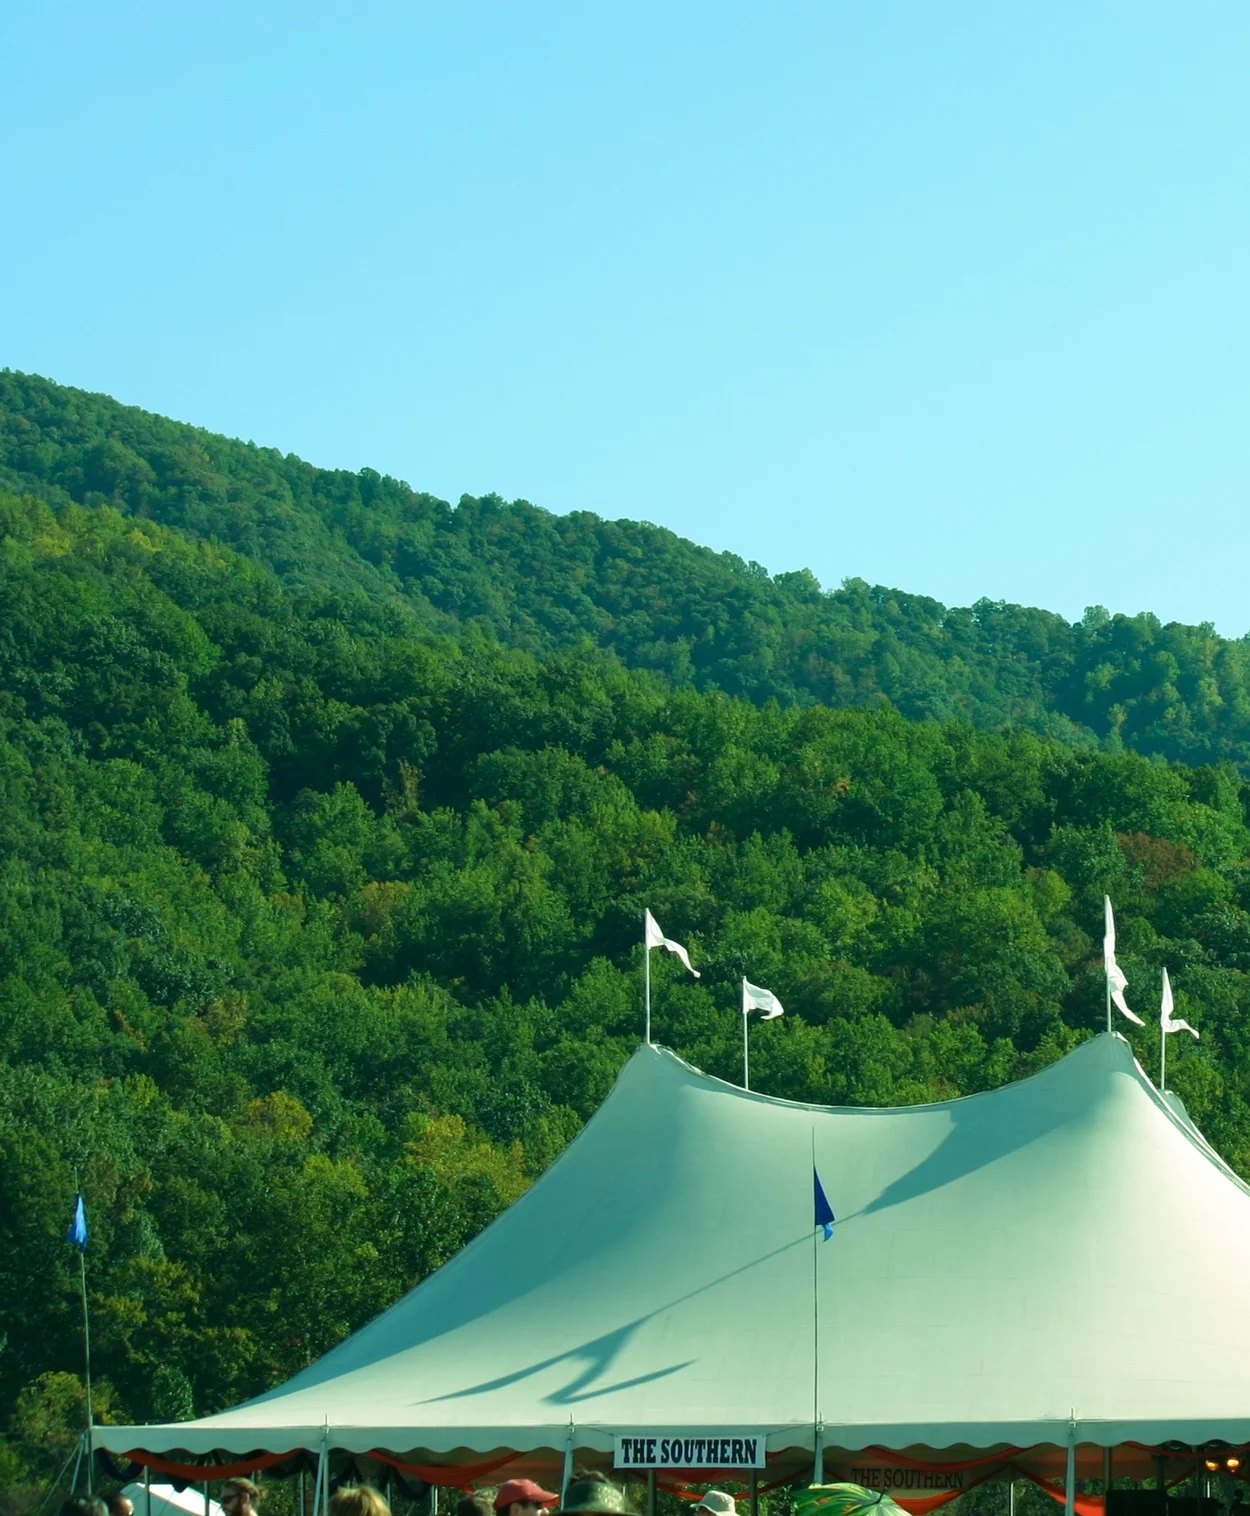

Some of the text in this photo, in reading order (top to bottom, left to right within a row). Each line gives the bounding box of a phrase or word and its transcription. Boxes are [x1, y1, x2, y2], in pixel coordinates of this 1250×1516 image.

[621, 1439, 757, 1464] THE SOUTHERN
[851, 1469, 963, 1488] THE SOUTHERN
